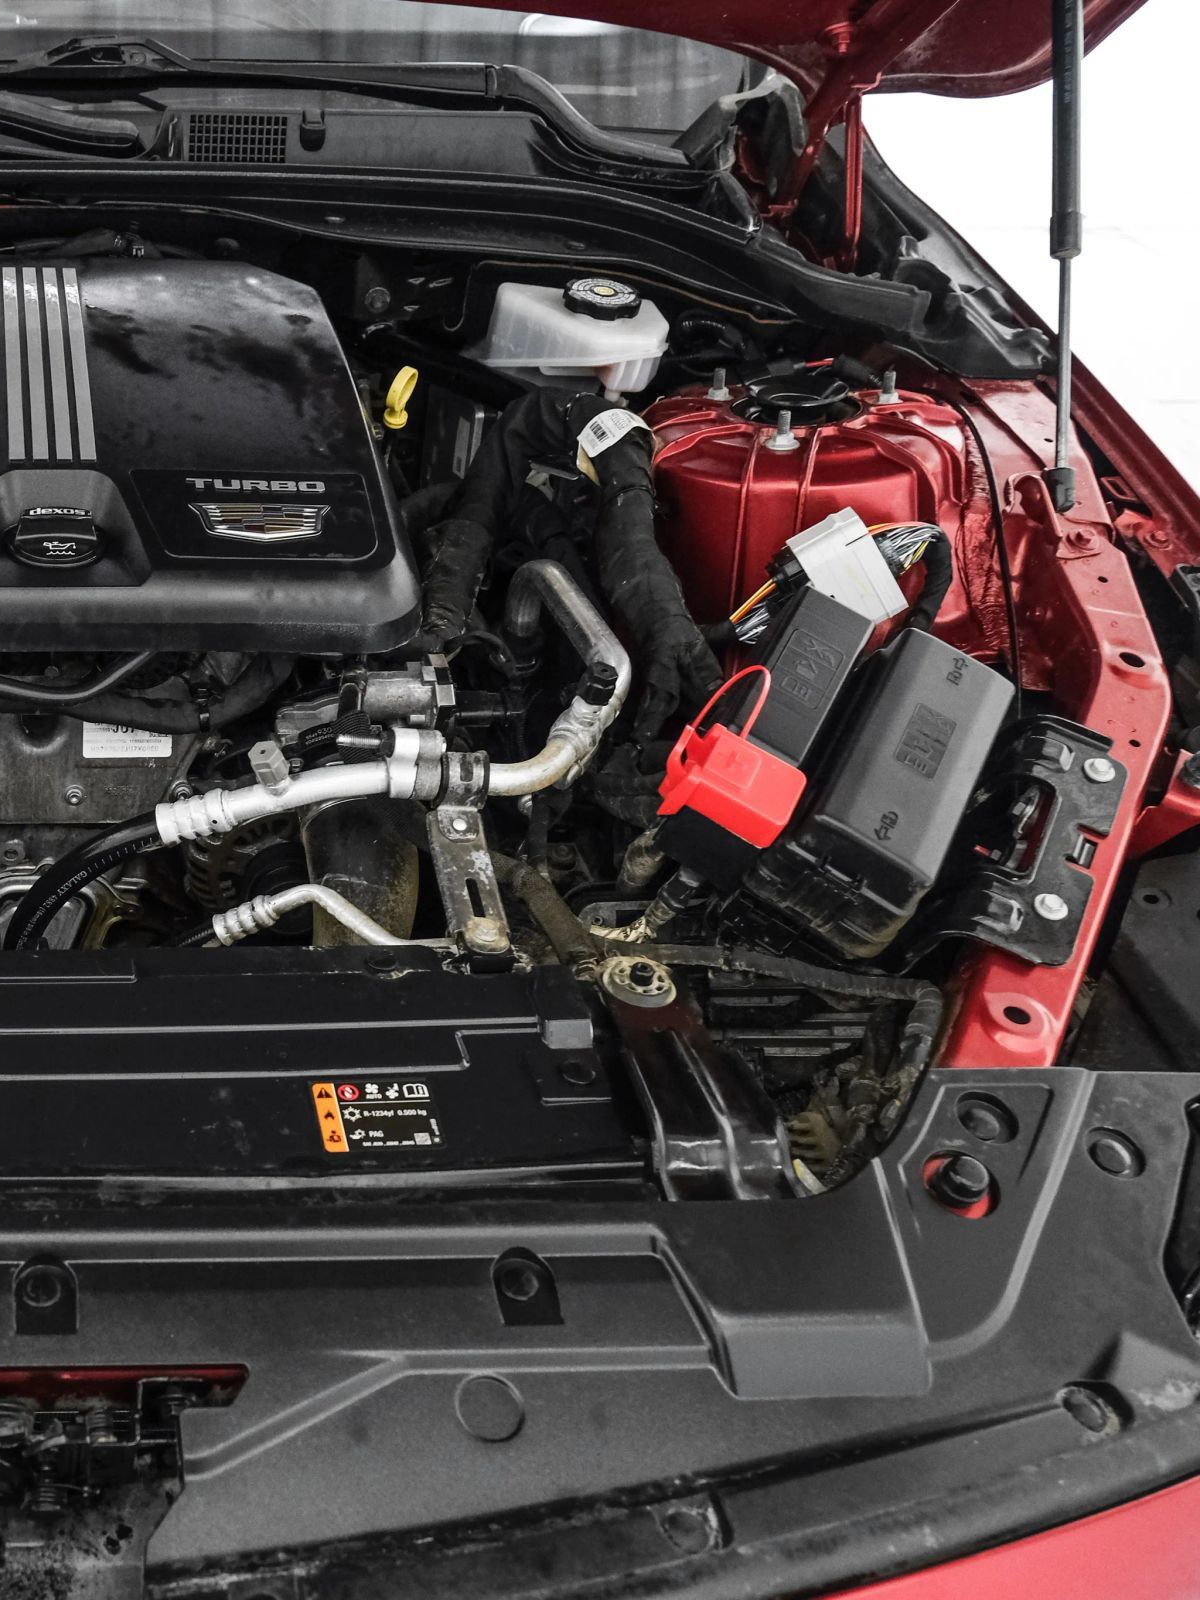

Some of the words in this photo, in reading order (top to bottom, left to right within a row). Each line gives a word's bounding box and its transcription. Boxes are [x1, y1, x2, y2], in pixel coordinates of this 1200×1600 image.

[186, 477, 326, 493] TURBO
[29, 507, 86, 516] dexos
[57, 870, 88, 896] GALAXY
[368, 1130, 384, 1138] PAG
